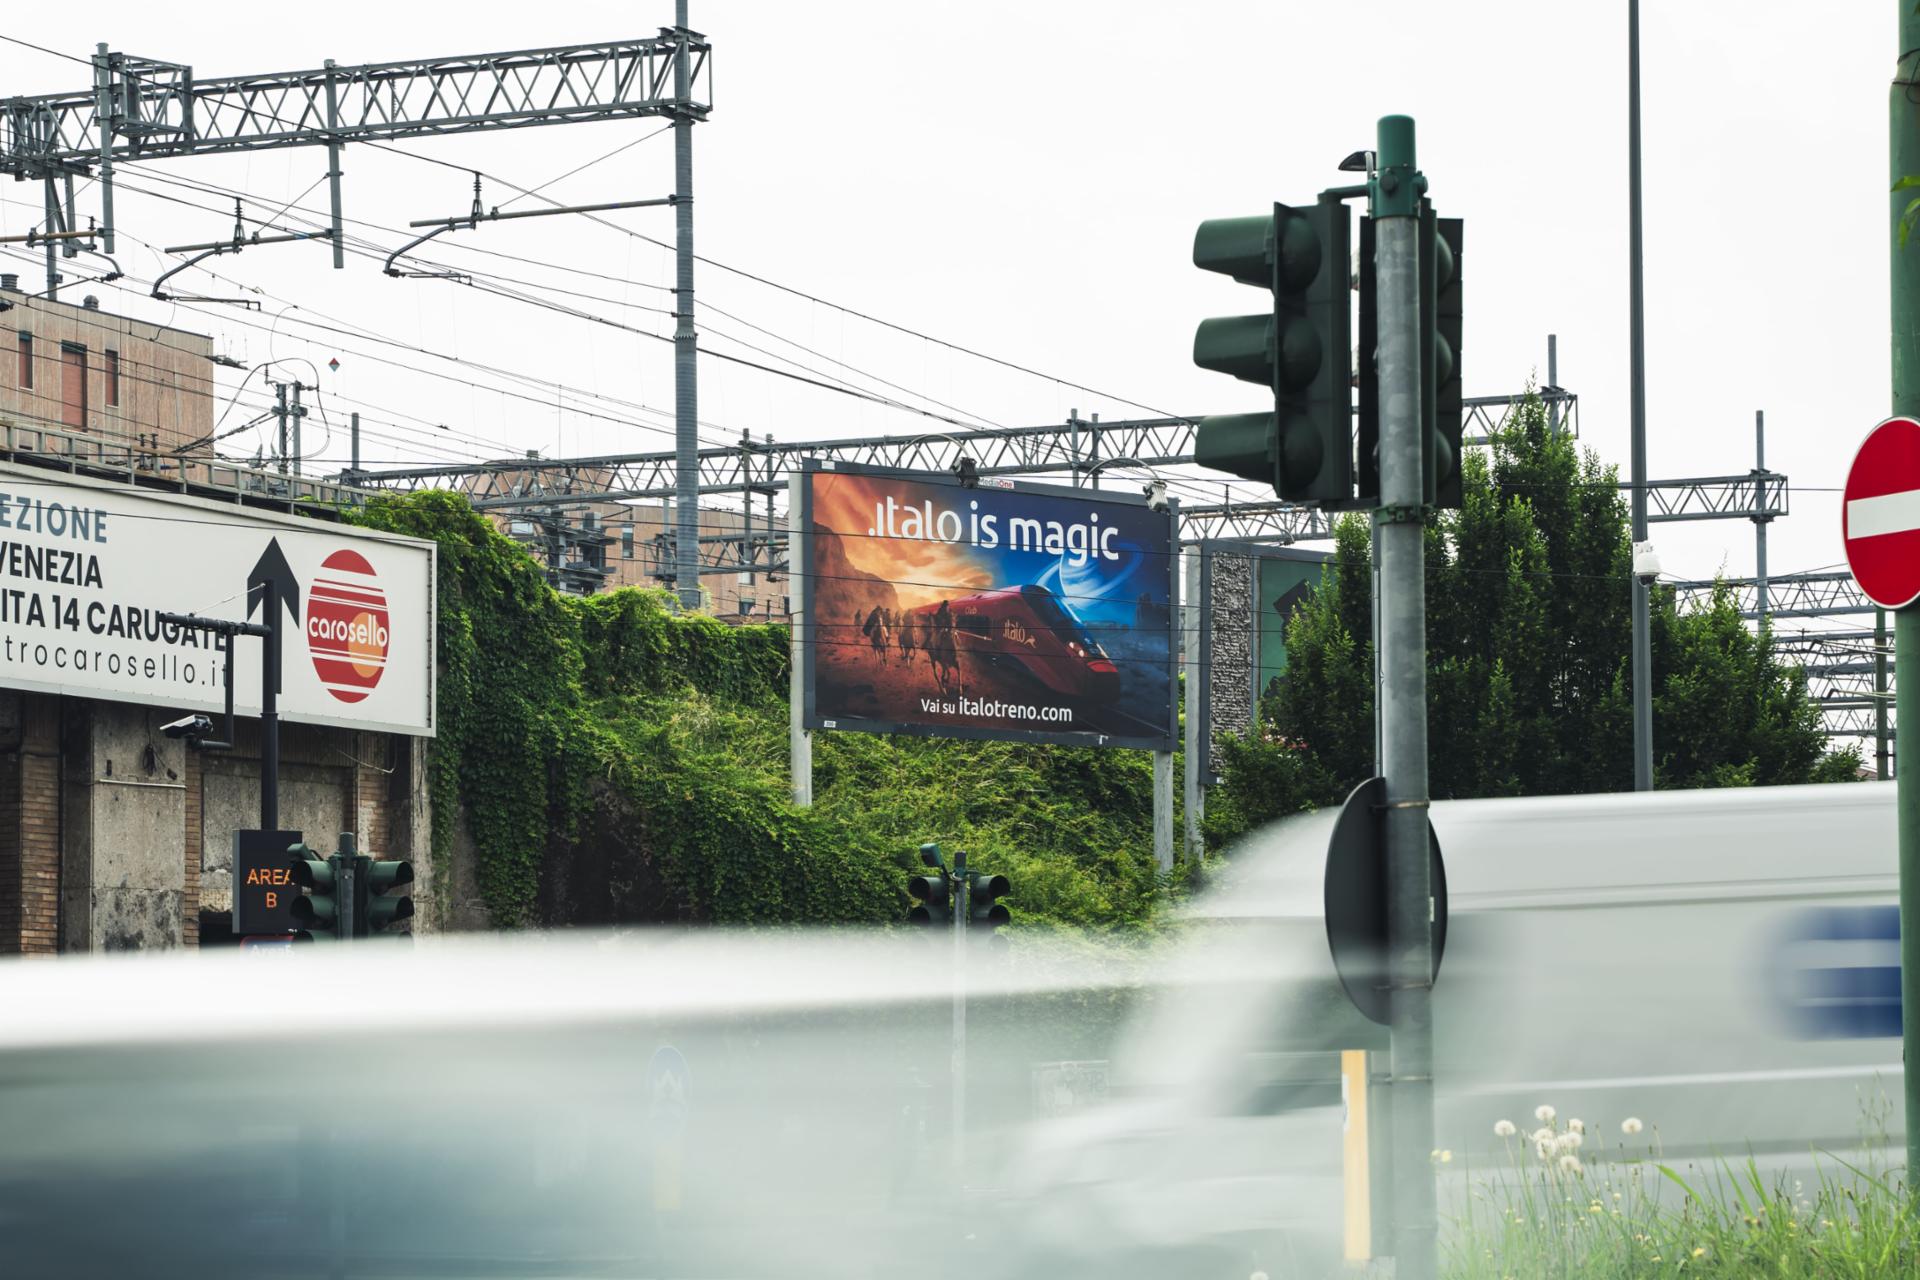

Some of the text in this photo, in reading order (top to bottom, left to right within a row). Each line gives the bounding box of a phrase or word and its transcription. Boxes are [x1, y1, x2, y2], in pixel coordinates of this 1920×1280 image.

[970, 500, 999, 549] is
[1009, 512, 1119, 567] magic
[2, 588, 46, 628] ITA
[52, 594, 80, 632] 14
[308, 613, 388, 648] carosello
[921, 696, 1072, 722] Vai su italotreno.com
[266, 892, 277, 908] B
